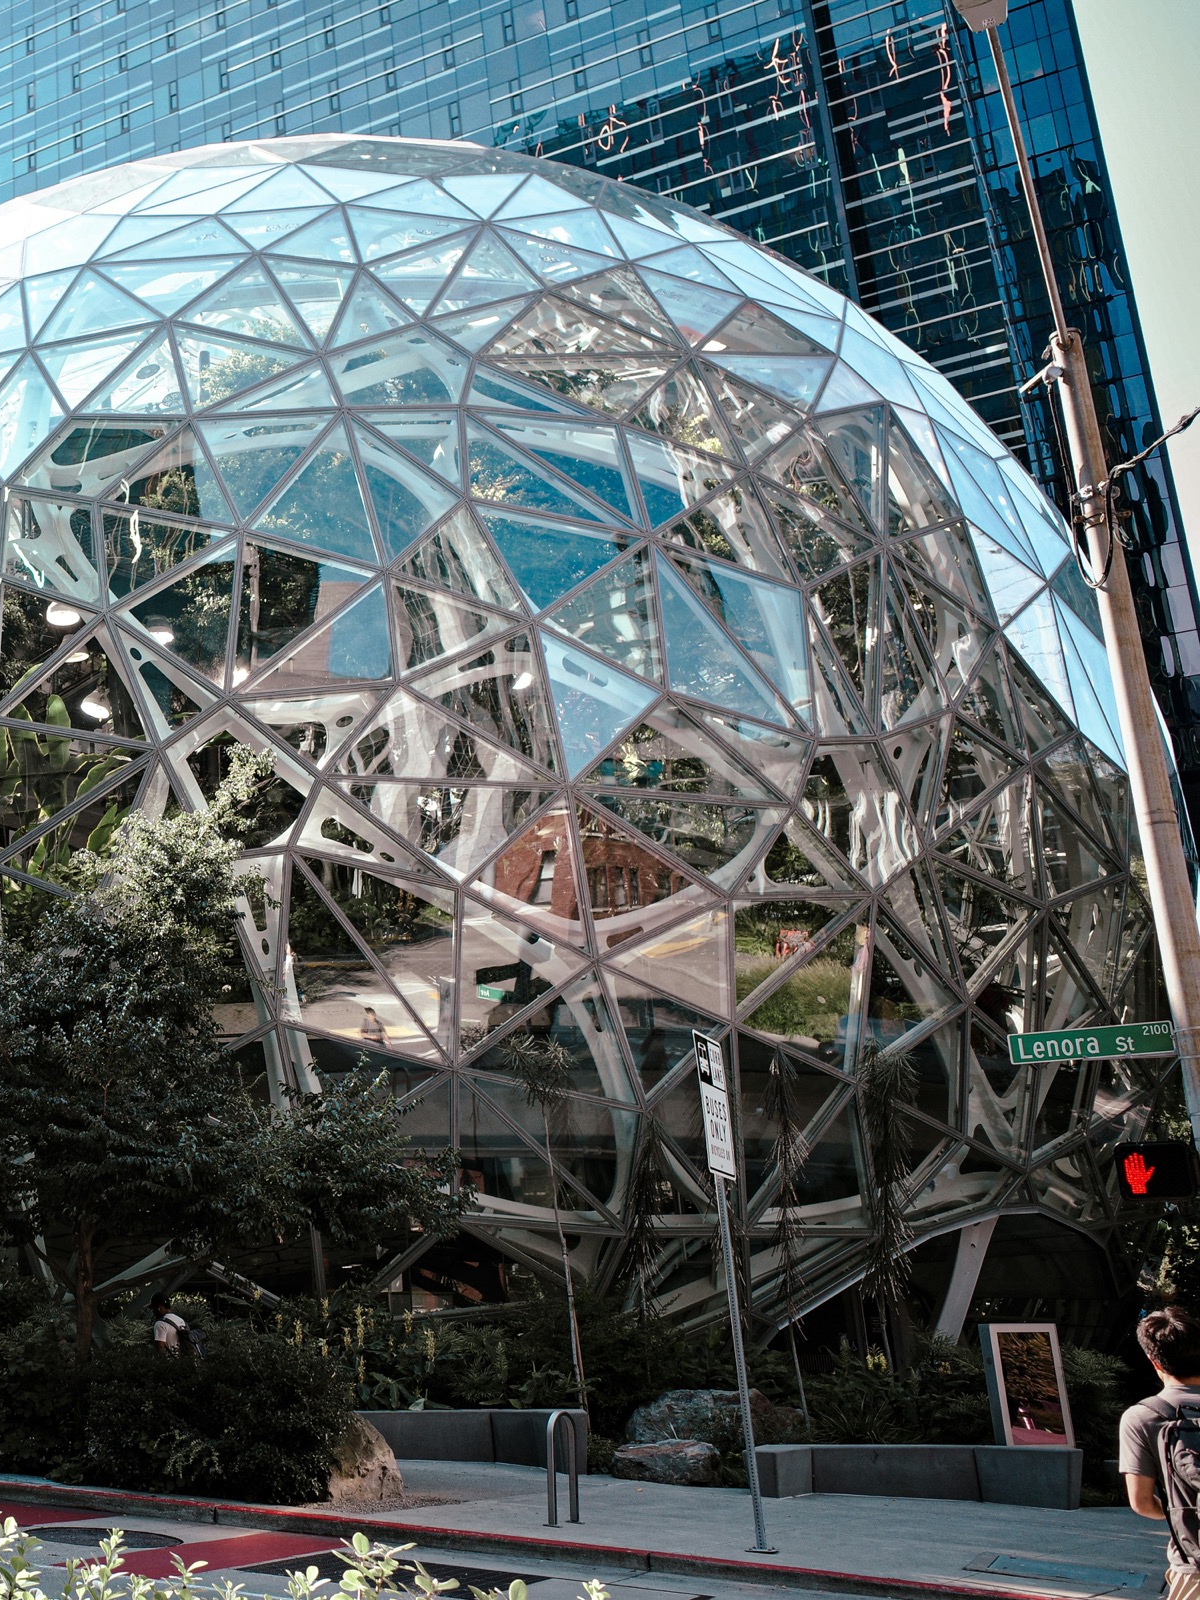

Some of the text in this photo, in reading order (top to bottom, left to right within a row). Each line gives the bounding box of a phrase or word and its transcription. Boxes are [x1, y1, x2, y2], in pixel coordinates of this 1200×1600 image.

[1141, 1024, 1169, 1036] 2100
[709, 1048, 721, 1066] CURB
[1018, 1036, 1135, 1060] Lenora St
[712, 1066, 724, 1084] LANE
[705, 1095, 727, 1122] BUSES
[710, 1119, 727, 1143] ONLY
